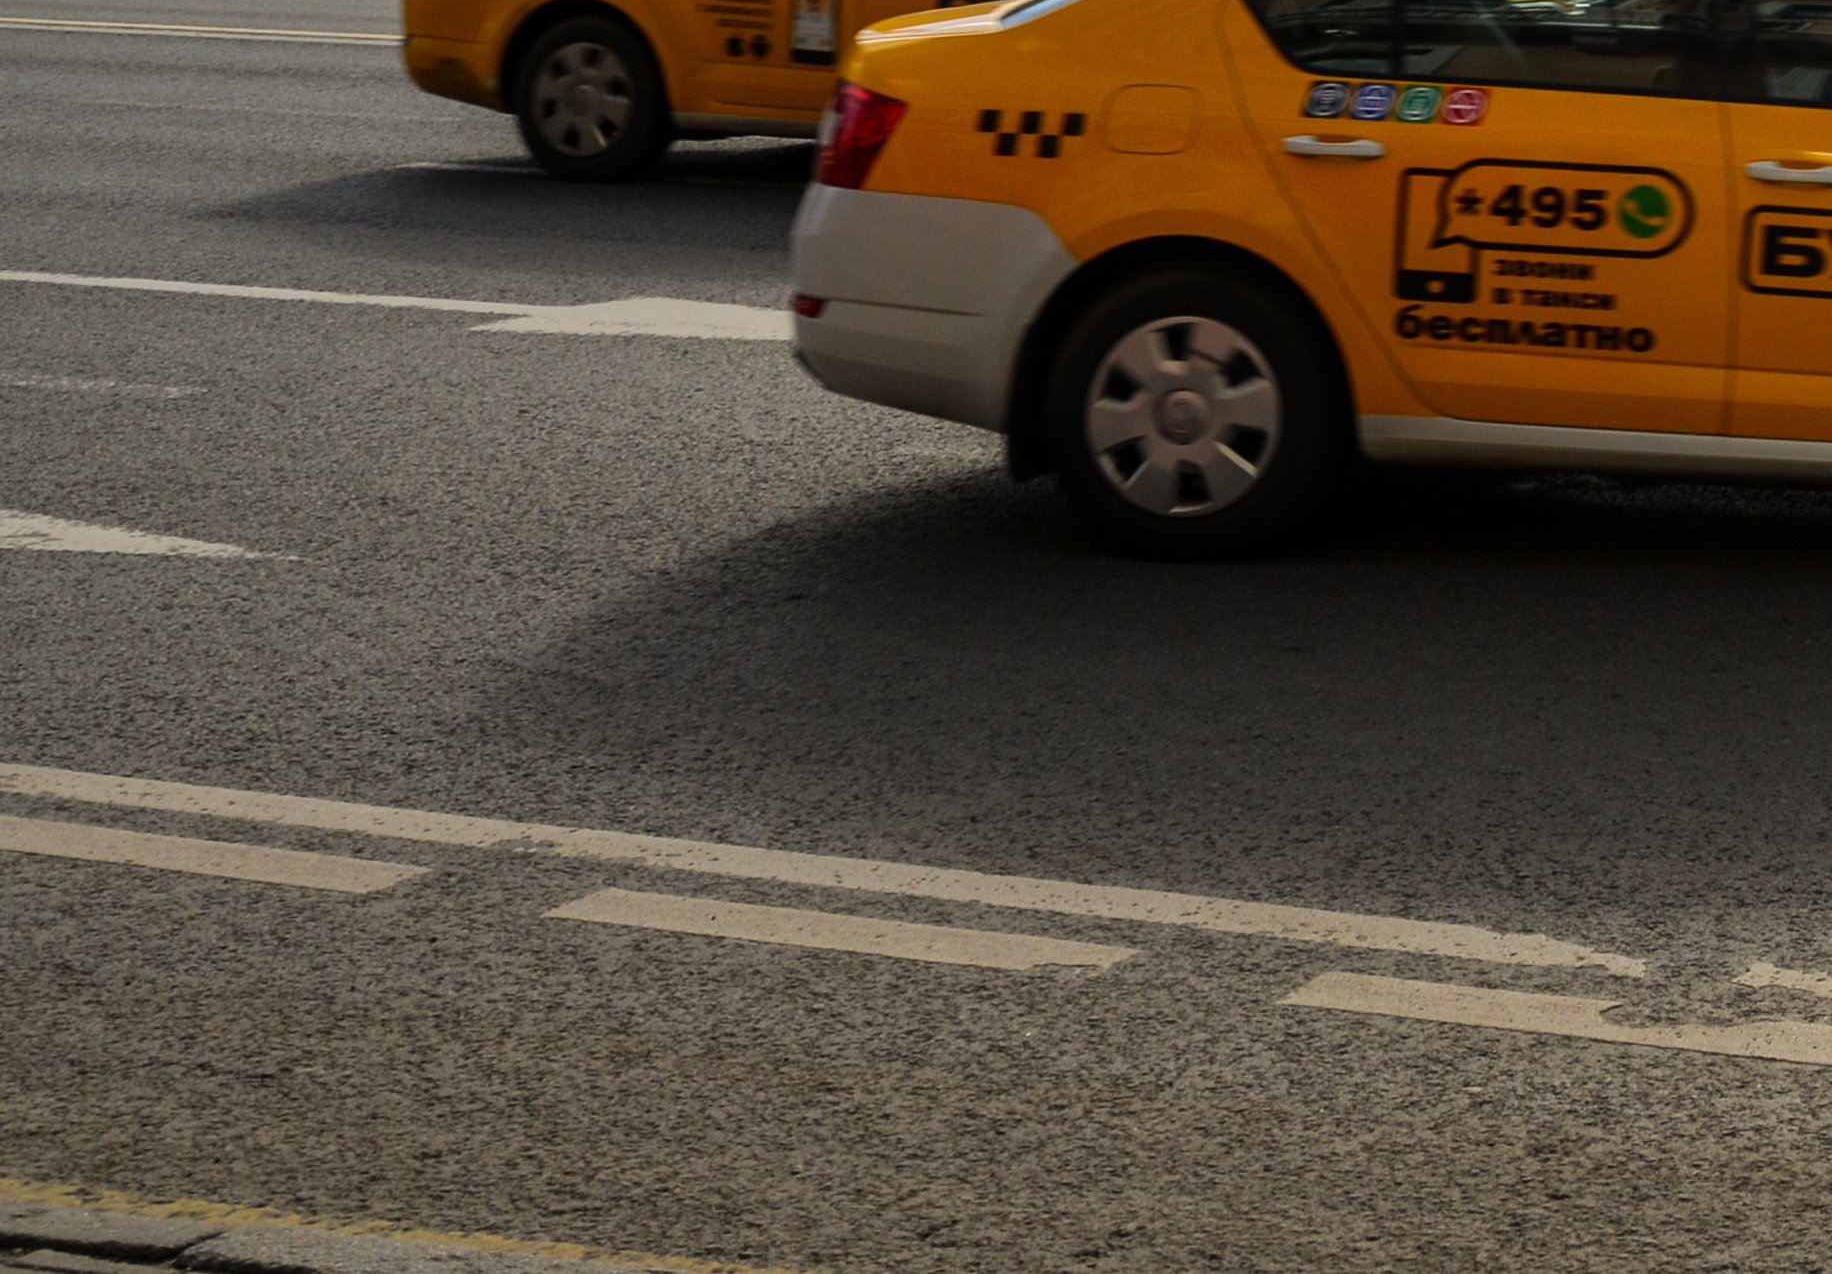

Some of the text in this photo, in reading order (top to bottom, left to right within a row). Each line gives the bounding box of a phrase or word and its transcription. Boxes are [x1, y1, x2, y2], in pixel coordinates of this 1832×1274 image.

[1491, 259, 1597, 283] звони
[1491, 288, 1620, 313] в такси
[1396, 304, 1657, 353] бесплатно
